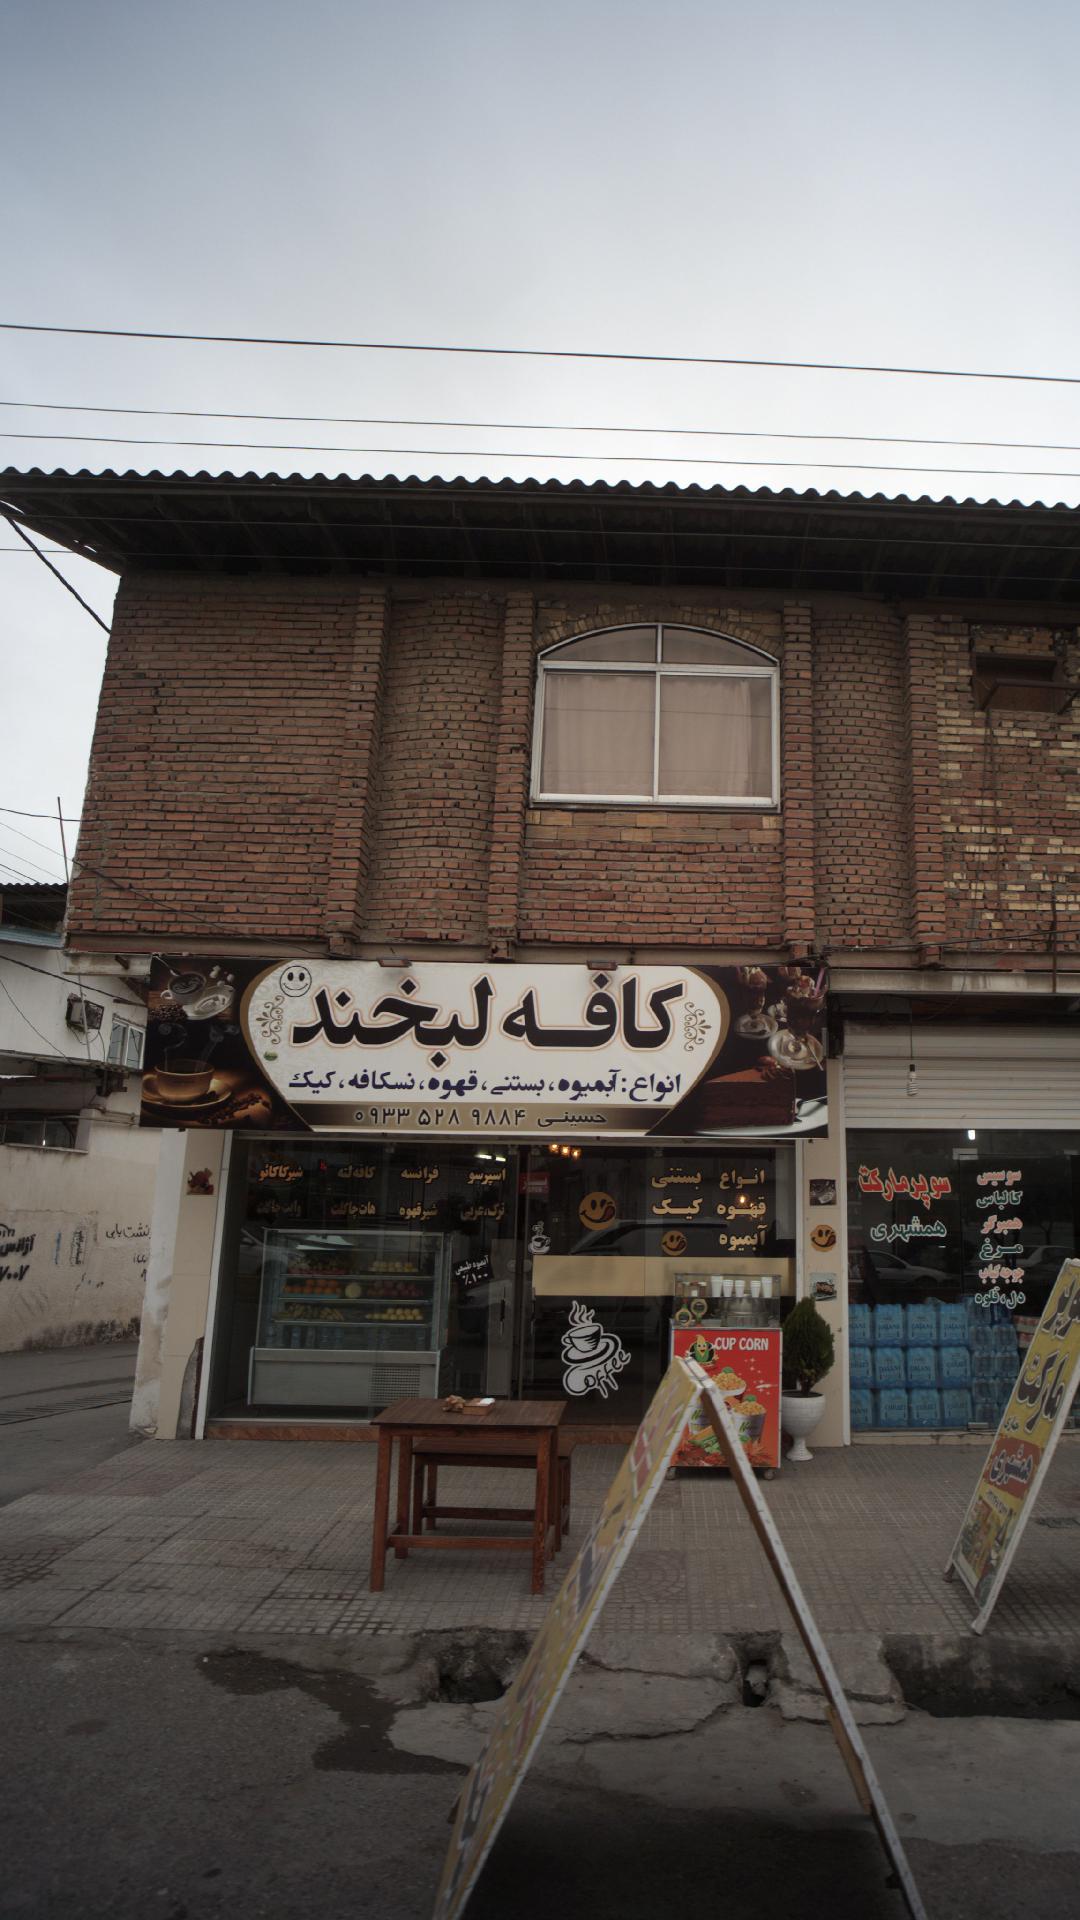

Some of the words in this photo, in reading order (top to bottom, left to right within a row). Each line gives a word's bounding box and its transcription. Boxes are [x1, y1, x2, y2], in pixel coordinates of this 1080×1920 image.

[291, 974, 495, 1067] لبخند
[502, 973, 684, 1048] کافه
[288, 1071, 337, 1094] کیک
[355, 1107, 410, 1125] ۰۹۳۳
[418, 1108, 460, 1126] ۵۲۸
[471, 1108, 526, 1126] ۹۸۸۴
[537, 1111, 607, 1127] حسینی
[651, 1167, 702, 1190] بستنی
[719, 1168, 765, 1189] انواع
[652, 1198, 703, 1219] کیک
[717, 1196, 766, 1220] قهوه
[976, 1189, 1023, 1209] کالباس
[719, 1224, 767, 1251] آبمیوه
[870, 1215, 947, 1243] همشهری
[979, 1237, 1023, 1260] مرغ
[714, 1337, 737, 1351] CUP
[739, 1338, 769, 1351] CORN
[1017, 1351, 1069, 1433] مارکت
[991, 1443, 1033, 1486] همشهری
